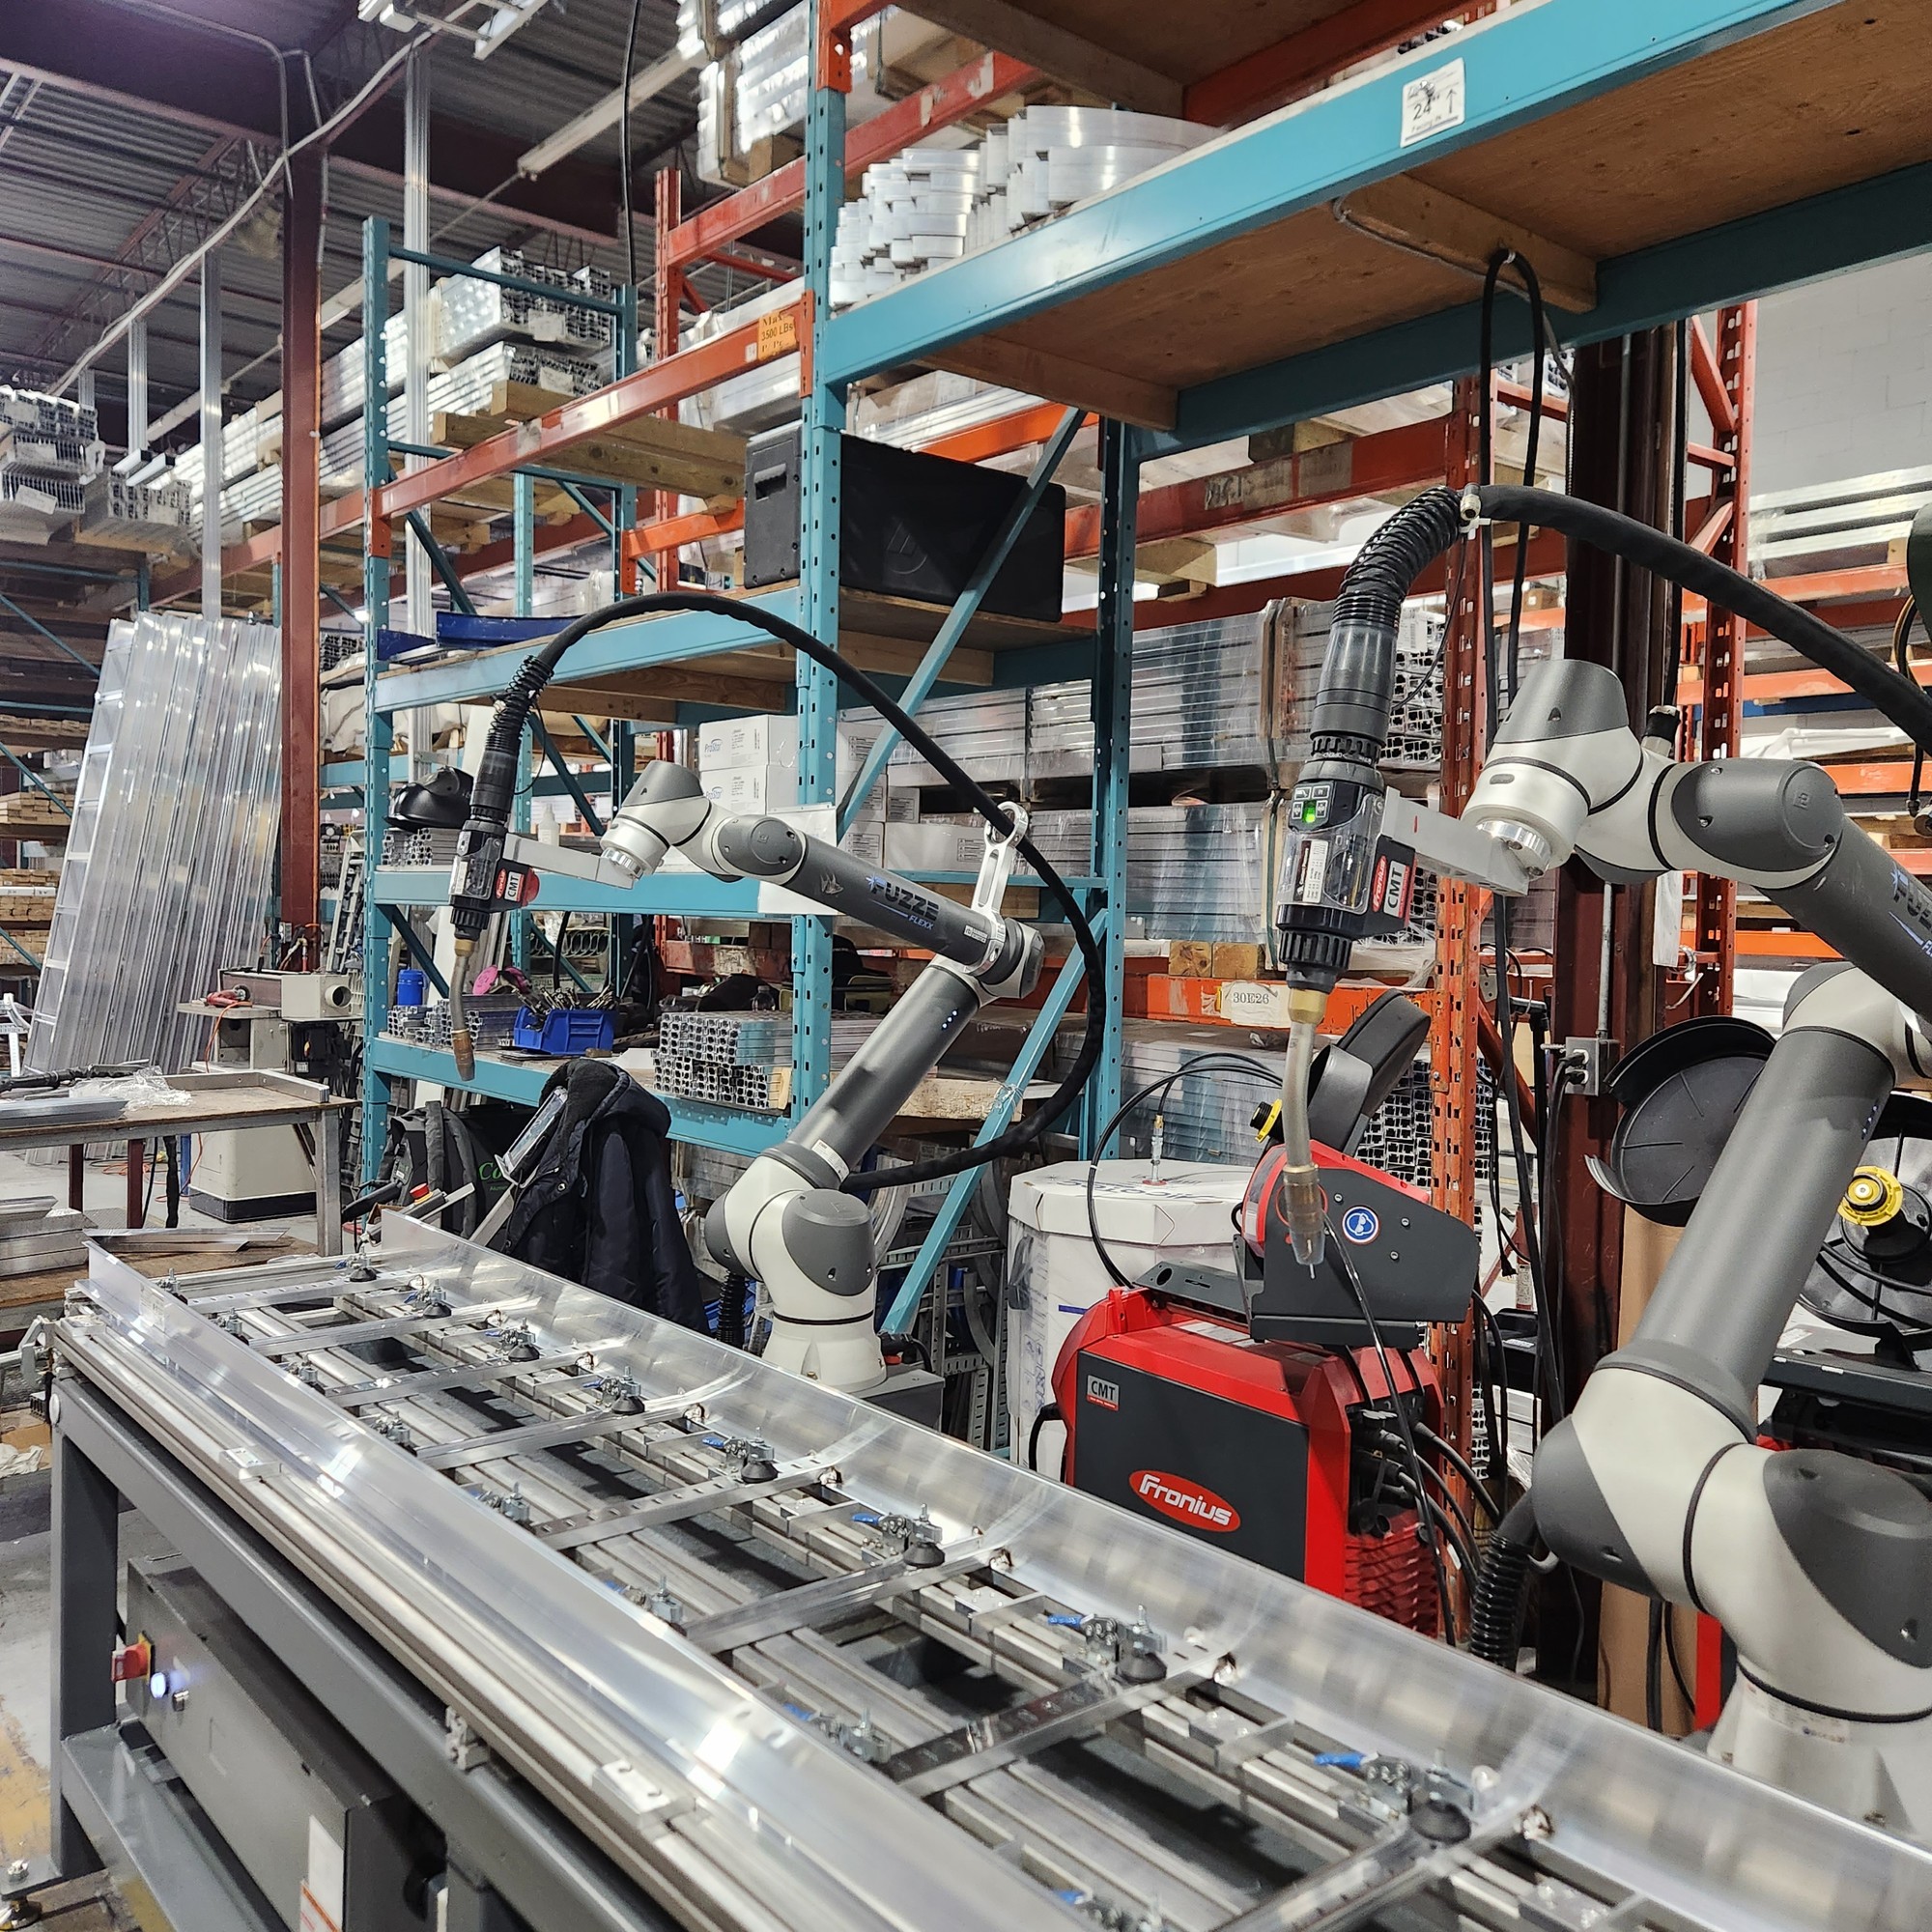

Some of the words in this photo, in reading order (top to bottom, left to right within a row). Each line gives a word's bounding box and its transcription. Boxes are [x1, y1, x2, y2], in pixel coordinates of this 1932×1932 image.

[508, 876, 520, 897] CMT
[1373, 857, 1387, 909] Fronius
[1387, 867, 1403, 909] CMT
[908, 915, 934, 931] FLEXX
[1233, 991, 1269, 1005] 30E26
[1091, 1380, 1116, 1401] CMT
[1139, 1473, 1232, 1526] Fronius
